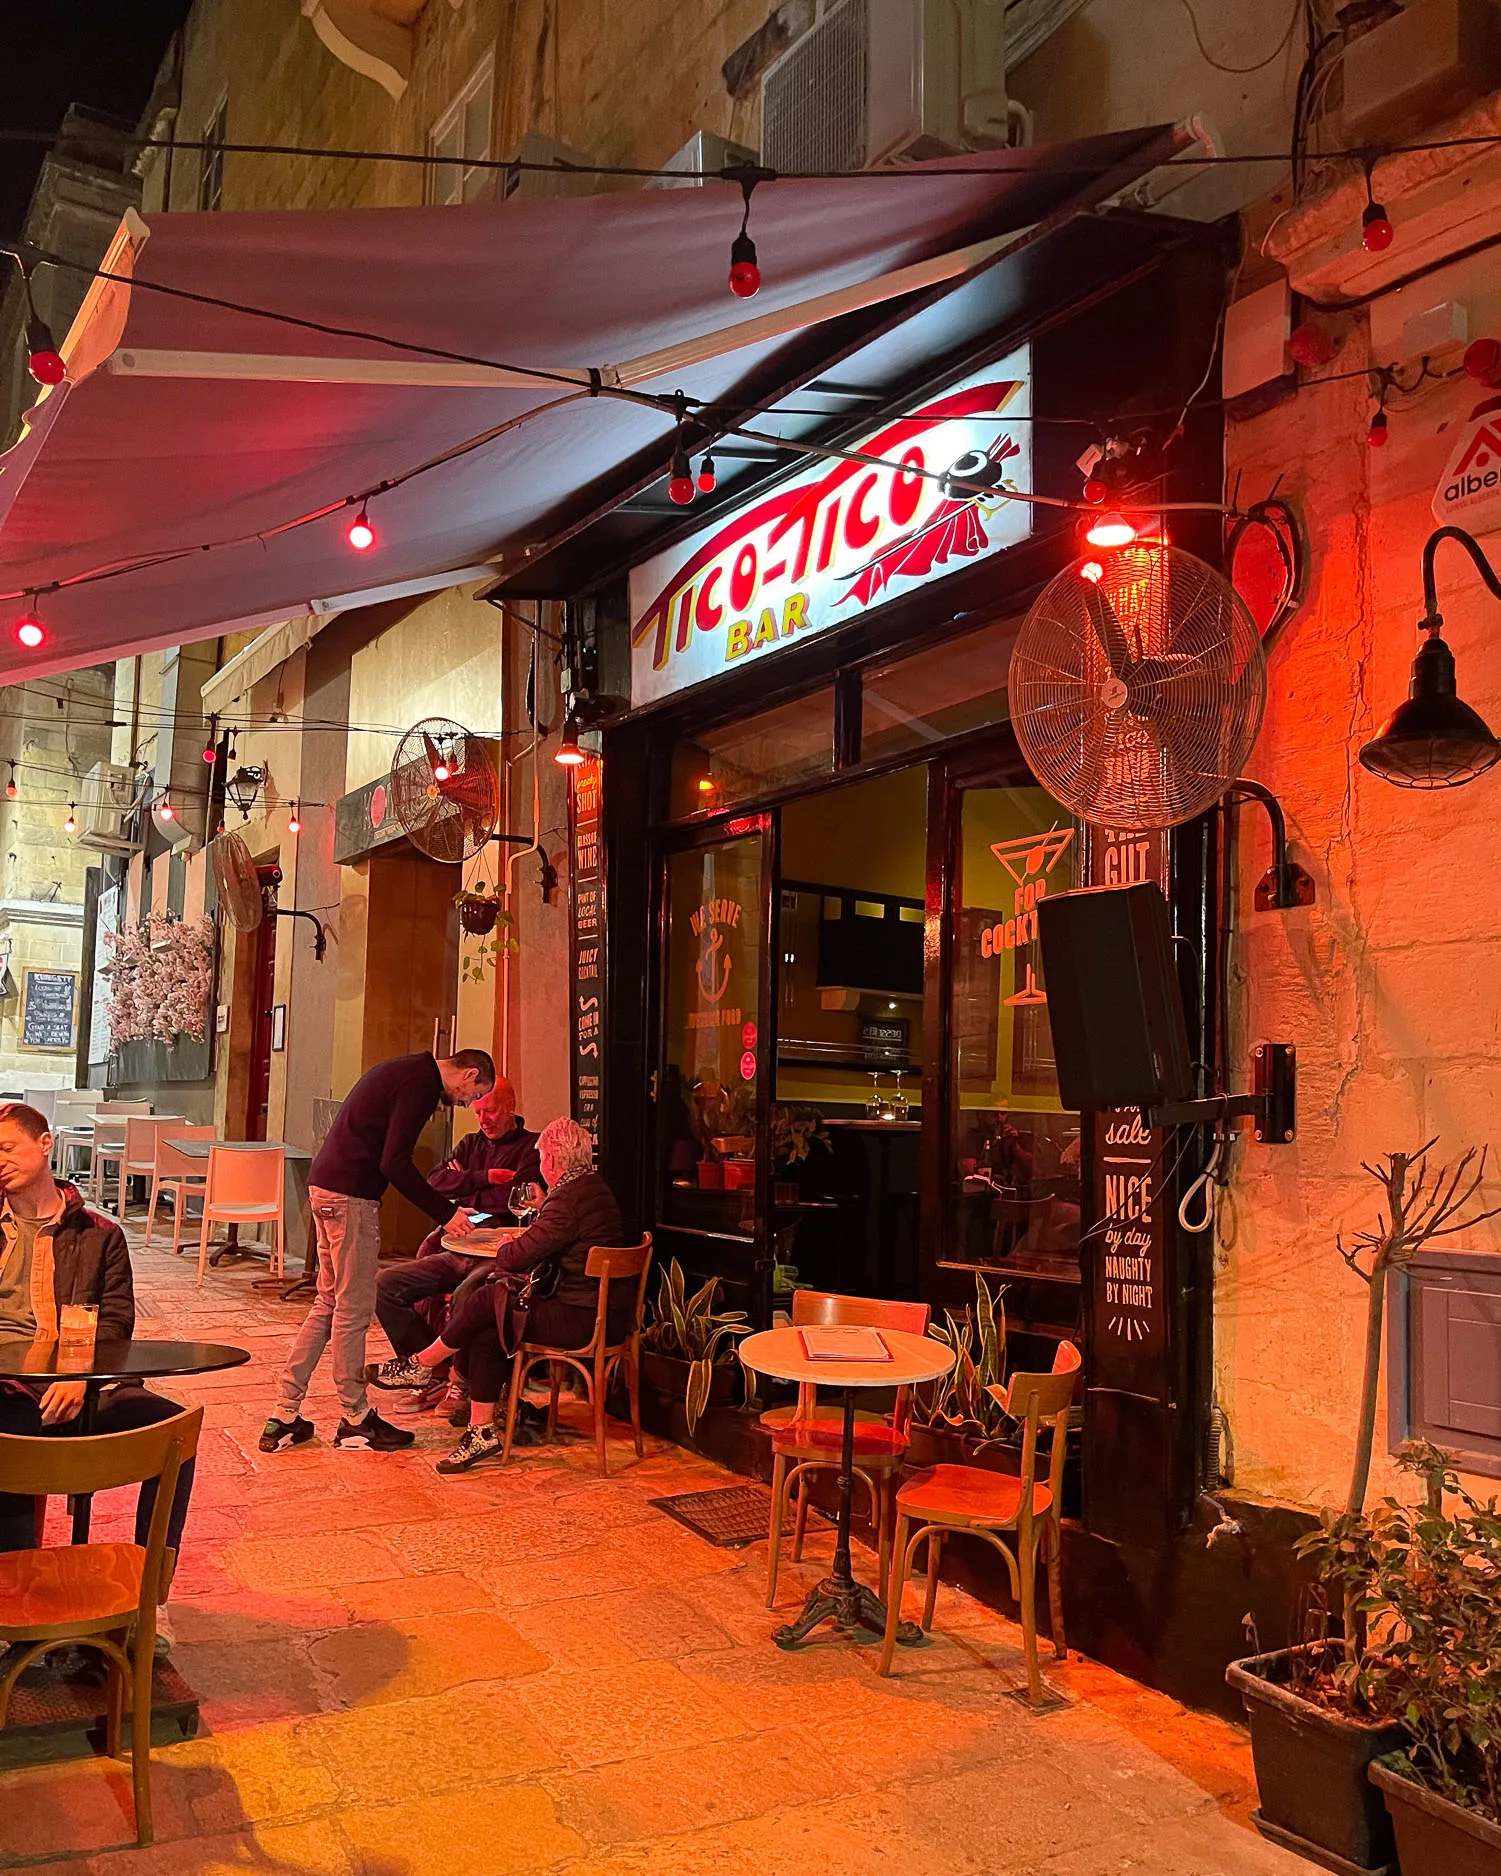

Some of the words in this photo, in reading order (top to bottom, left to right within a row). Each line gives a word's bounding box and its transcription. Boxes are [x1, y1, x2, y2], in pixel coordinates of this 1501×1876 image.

[1444, 470, 1501, 501] albe
[632, 381, 1024, 671] TICO-TICO
[725, 592, 811, 662] BAR
[577, 790, 597, 813] SHOT
[578, 846, 597, 869] WINE
[578, 904, 597, 917] LOCAL
[578, 918, 598, 928] BEER
[690, 905, 707, 936] WE
[708, 899, 742, 928] SERVE
[981, 910, 1038, 959] COCKT
[578, 947, 598, 964] JUICY
[578, 1029, 592, 1040] FOR
[593, 1026, 599, 1036] A
[1105, 1113, 1152, 1144] sale
[1105, 1174, 1152, 1223] NICE
[1105, 1222, 1123, 1254] by
[1124, 1226, 1152, 1257] day
[1105, 1256, 1152, 1282] NAUGHTY
[1106, 1281, 1119, 1304] BY
[1122, 1283, 1153, 1309] NIGHT
